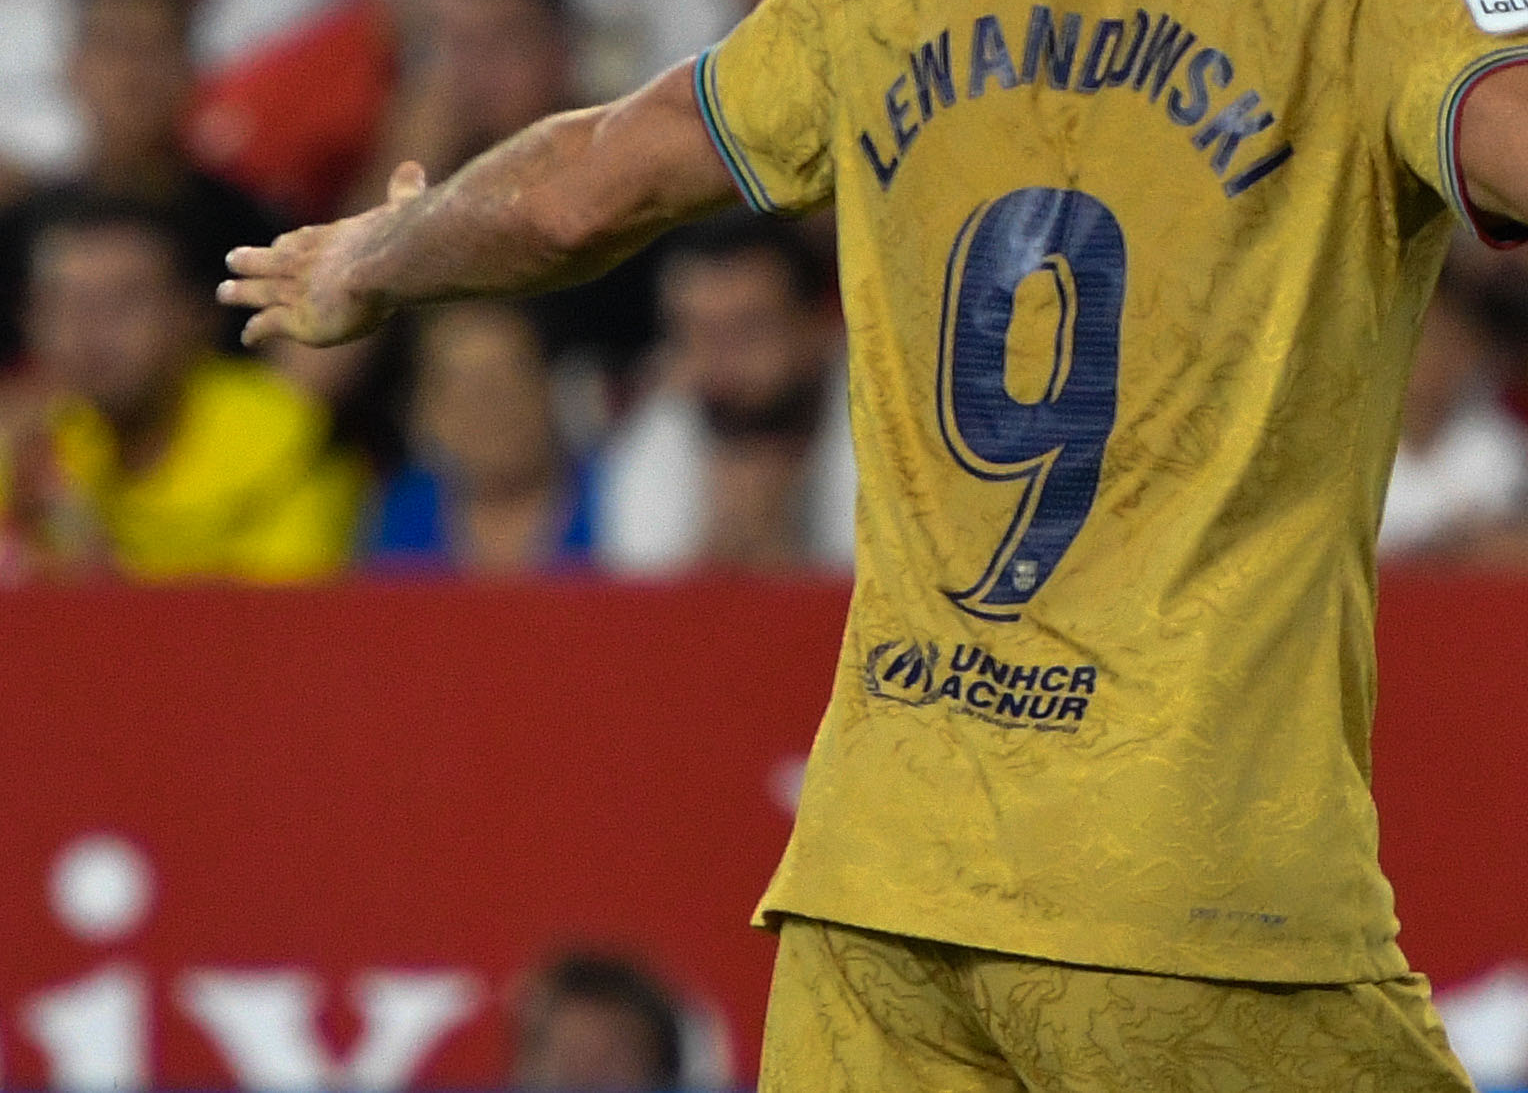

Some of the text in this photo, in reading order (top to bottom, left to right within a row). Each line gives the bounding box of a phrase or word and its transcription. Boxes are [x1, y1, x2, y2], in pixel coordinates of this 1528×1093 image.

[859, 5, 1295, 199] LEWANDOWSKI
[936, 186, 1128, 622] 9
[940, 674, 1089, 721] ACNUR
[950, 643, 1097, 695] UNHCR
